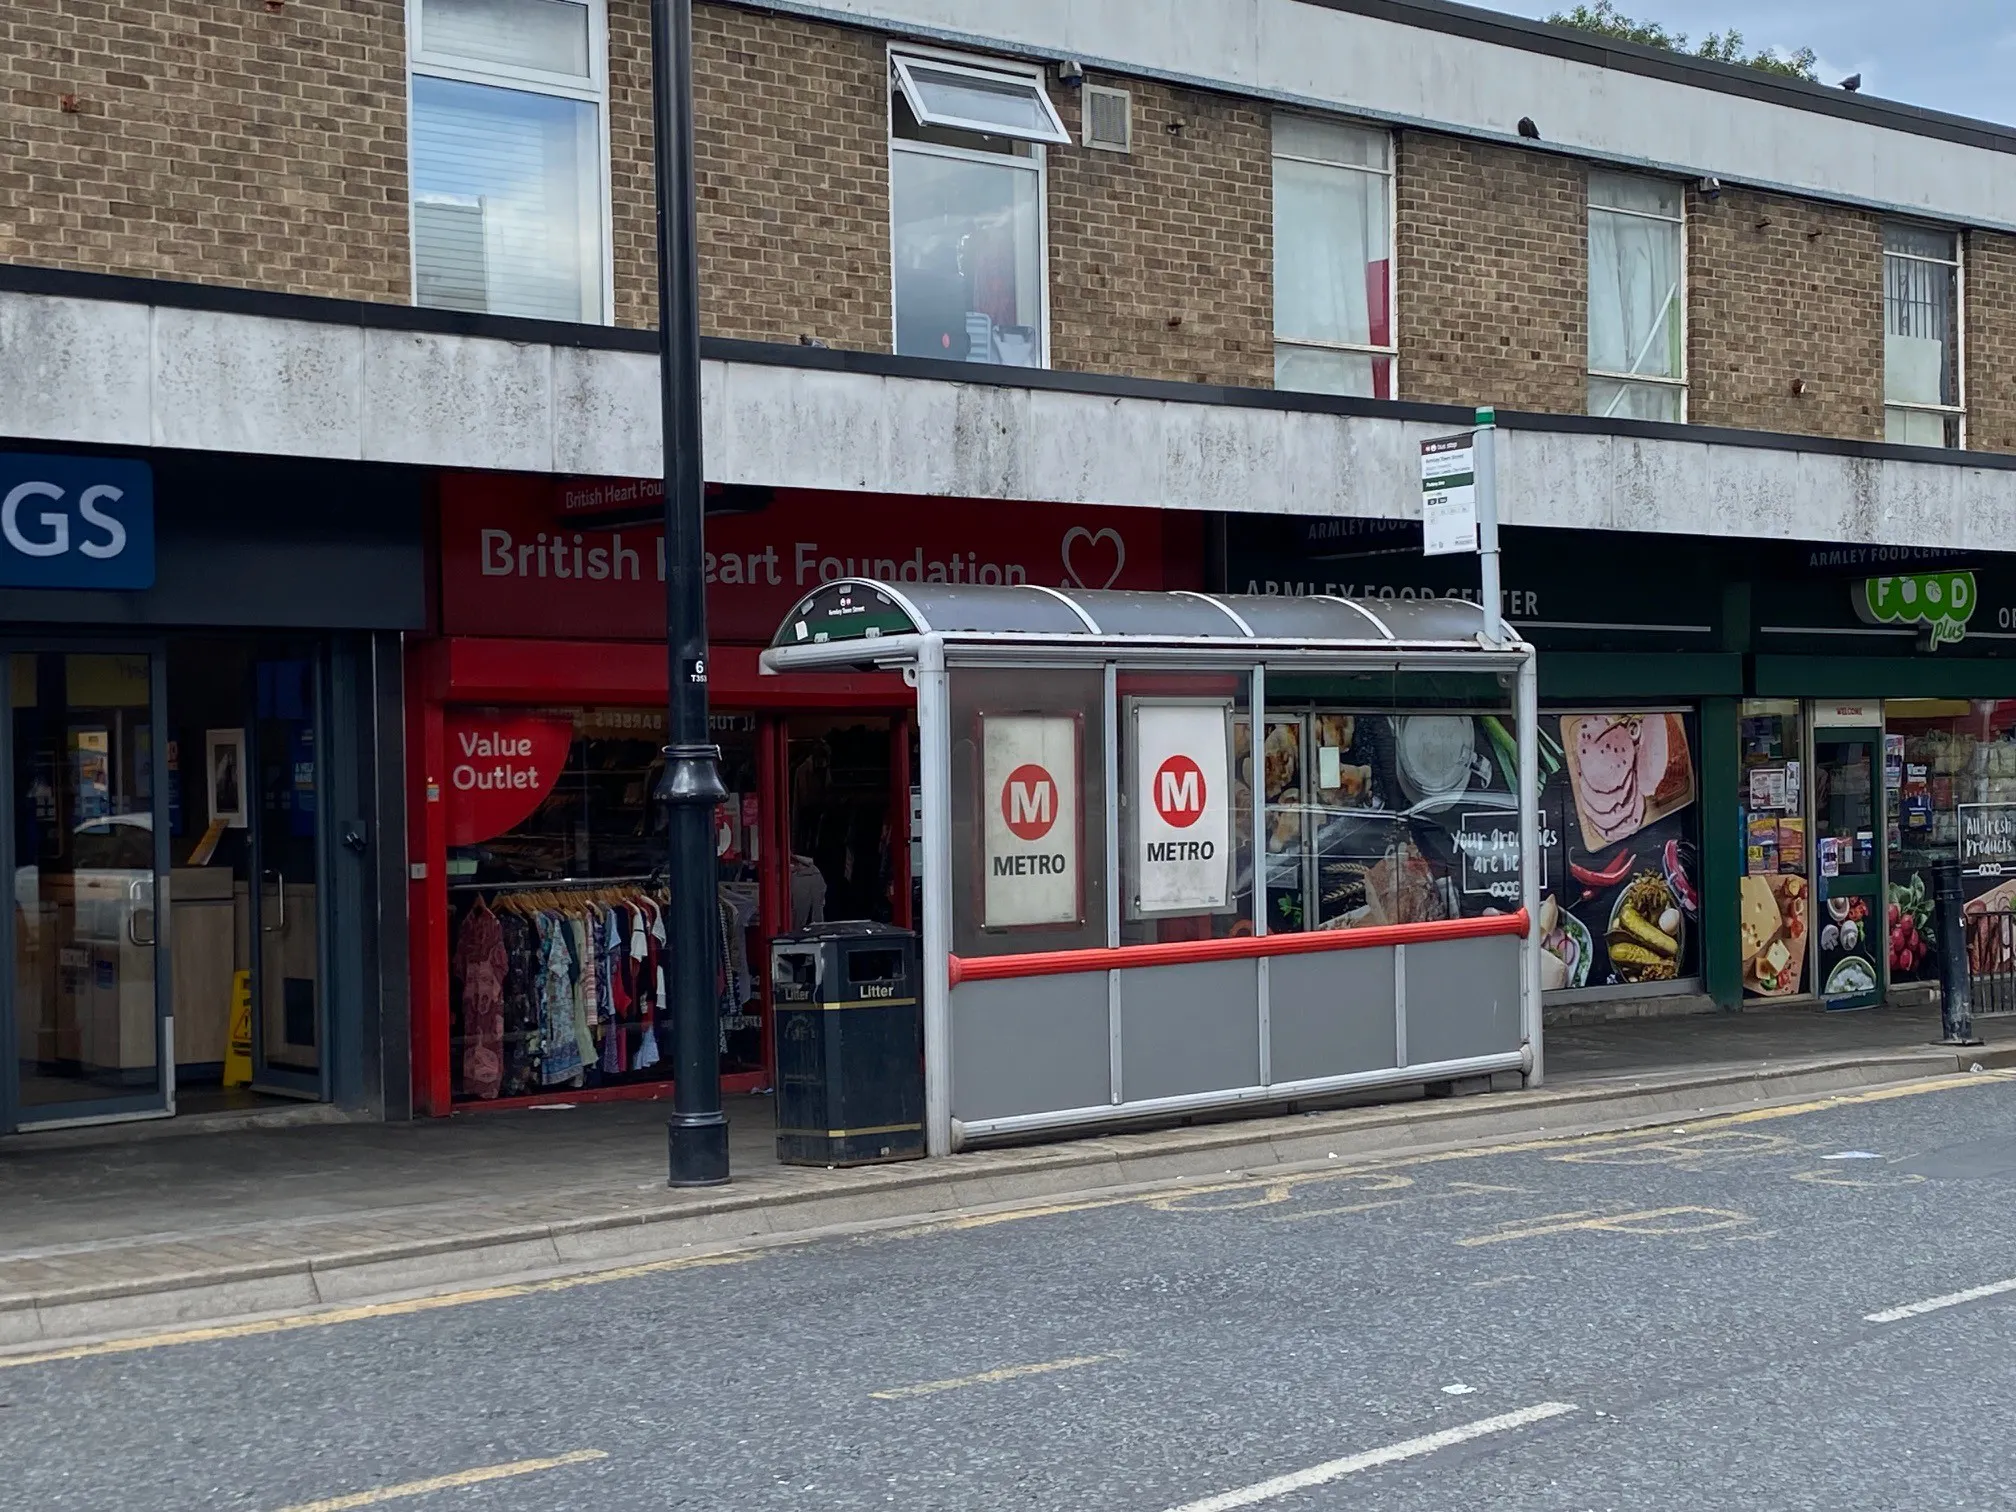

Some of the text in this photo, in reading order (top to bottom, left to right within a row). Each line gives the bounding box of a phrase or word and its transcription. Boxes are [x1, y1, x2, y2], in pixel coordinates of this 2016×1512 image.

[566, 486, 602, 509] British
[605, 483, 638, 503] Heart
[1, 480, 127, 559] GS
[1307, 518, 1365, 541] ARMLEY
[481, 528, 640, 581] British
[795, 542, 1026, 586] Foundation
[1808, 546, 1969, 567] ARMLEY FOOD CEN
[1931, 619, 1965, 649] plus
[695, 660, 704, 674] 6
[458, 731, 532, 757] Value
[453, 764, 540, 790] Outlet
[1010, 781, 1050, 824] M
[1161, 771, 1200, 812] M
[1966, 817, 1980, 835] All
[1491, 826, 1557, 851] groies
[1966, 836, 2012, 857] products
[1146, 840, 1215, 862] METRO
[993, 854, 1066, 876] METRO
[1473, 853, 1519, 873] are he
[785, 987, 810, 1000] Litter
[860, 985, 895, 999] Litter
